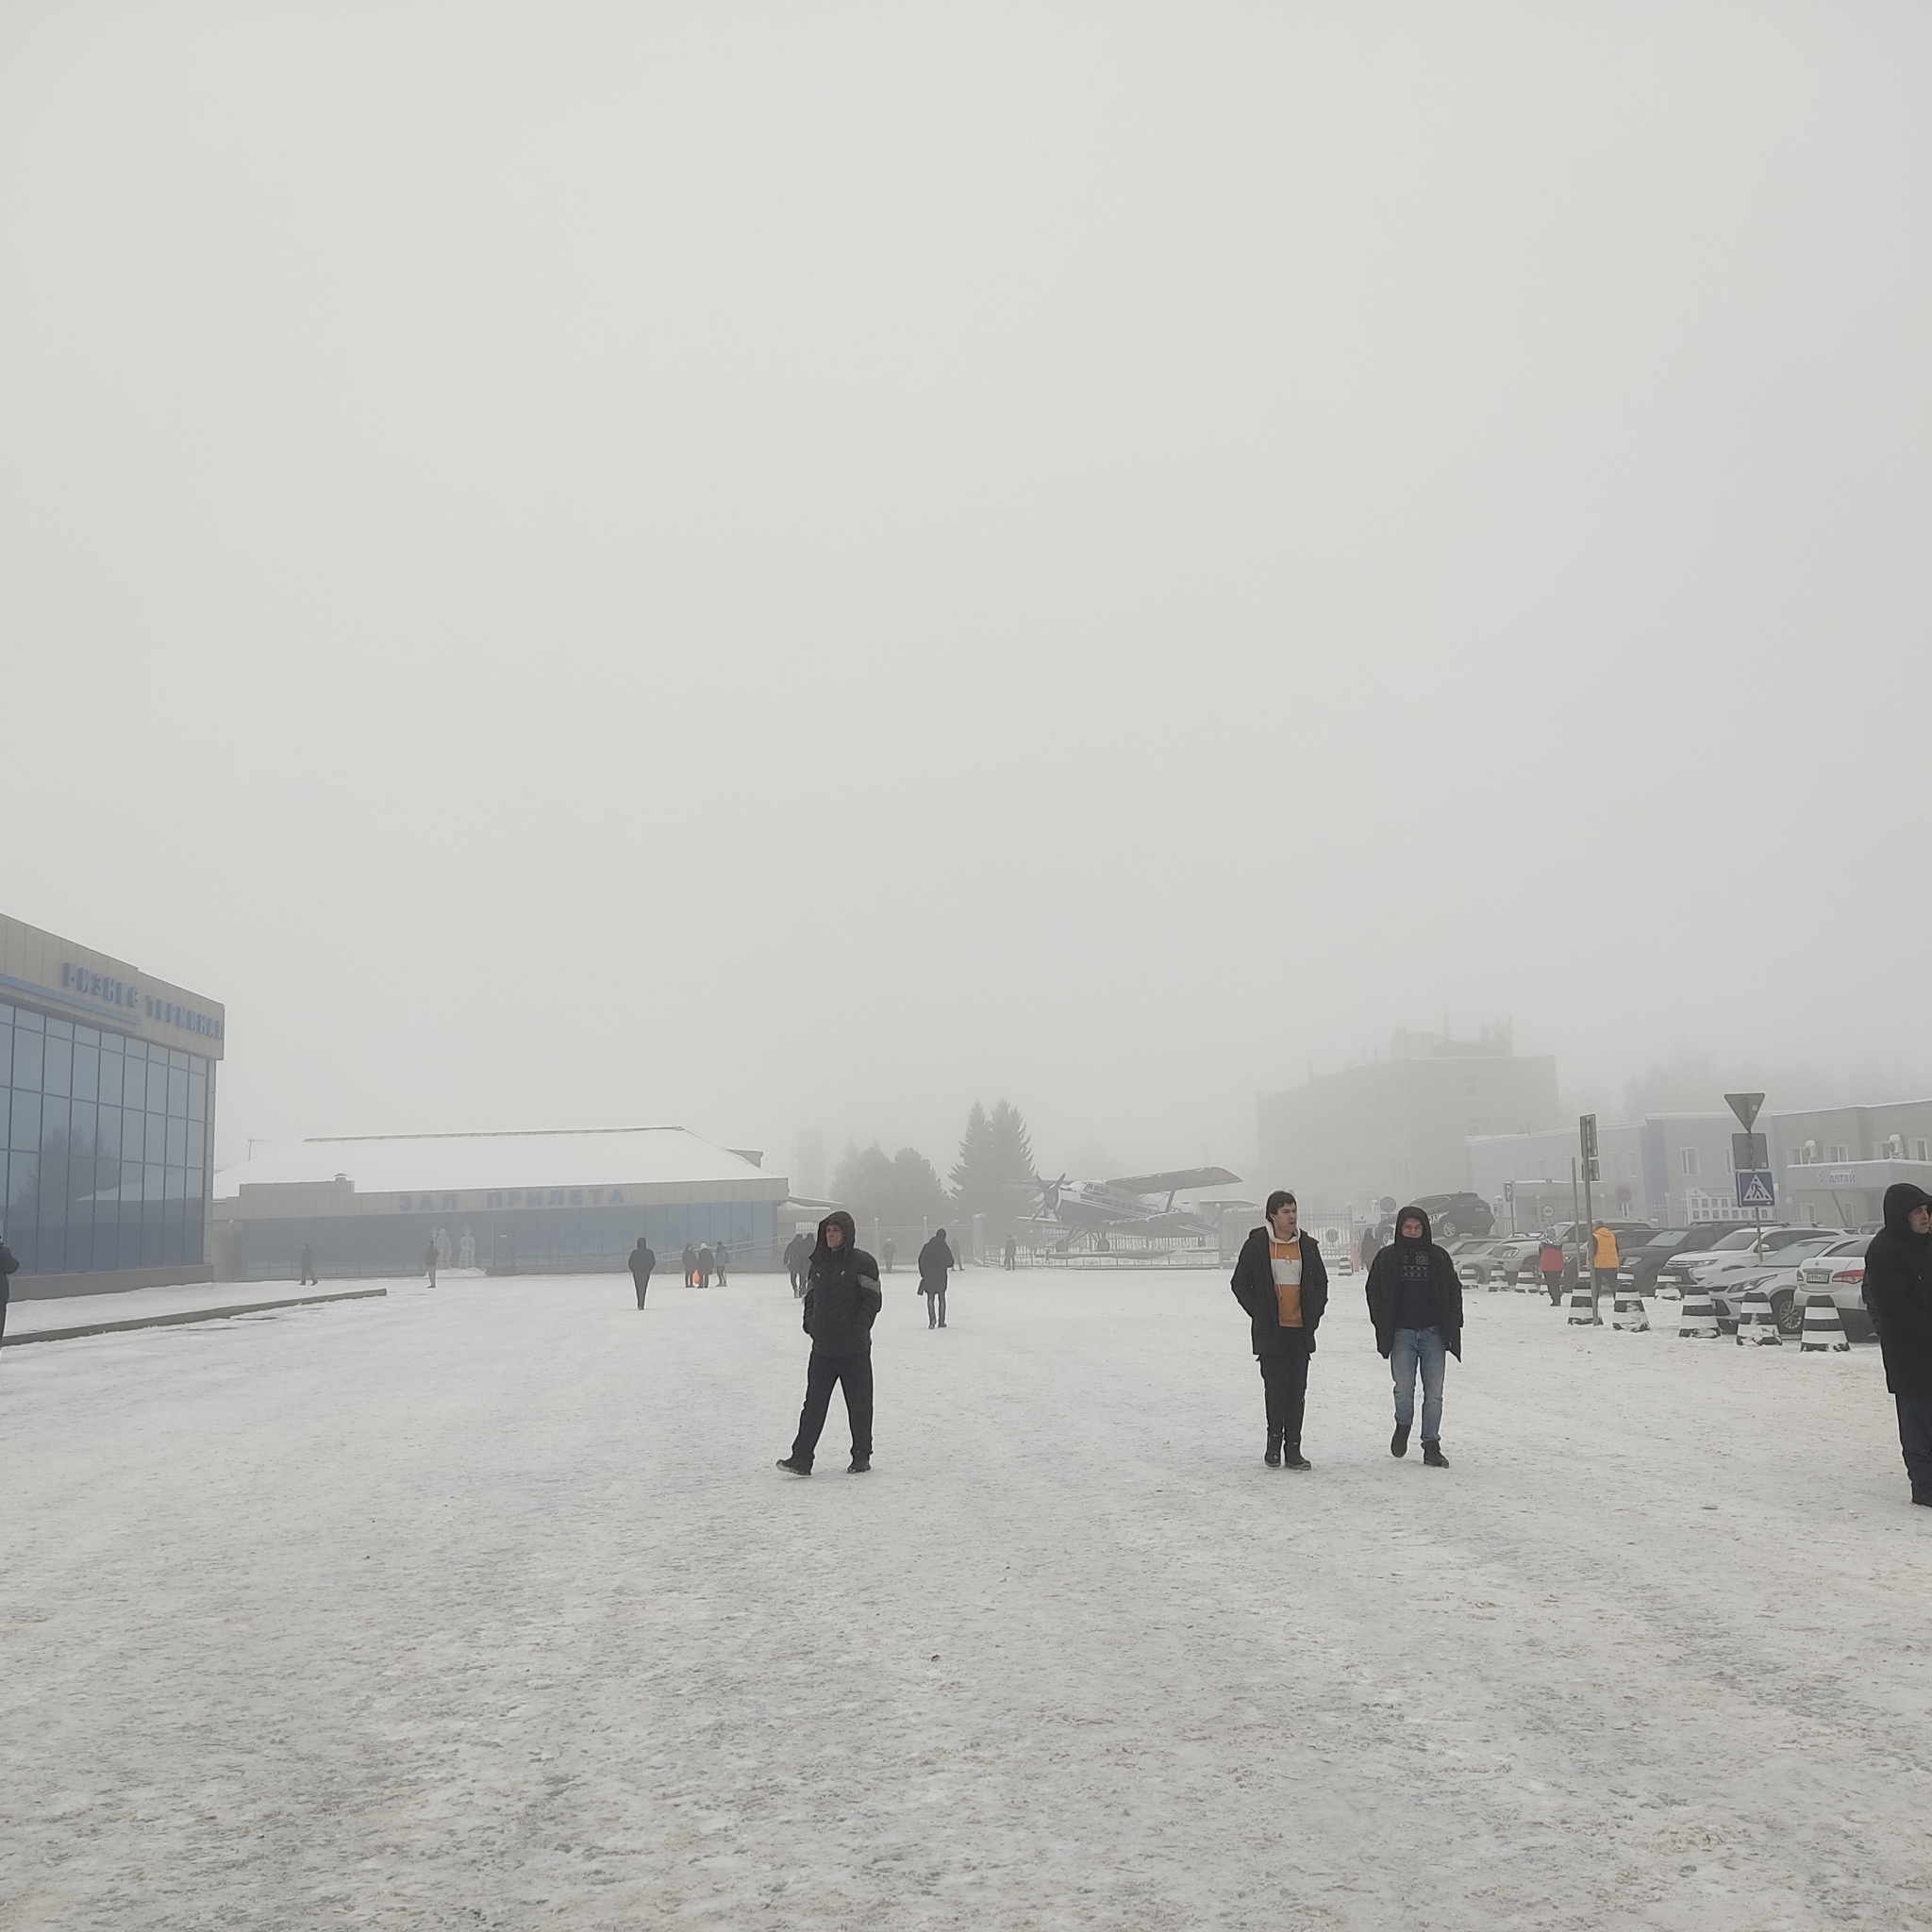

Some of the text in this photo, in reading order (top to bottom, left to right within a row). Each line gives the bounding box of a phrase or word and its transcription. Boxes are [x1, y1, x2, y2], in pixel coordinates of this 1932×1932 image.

[63, 962, 139, 1008] БИЗНЕС
[1828, 1170, 1856, 1183] АЛТАЙ
[398, 1188, 625, 1212] ЗАЛ ПРИЛЕТА
